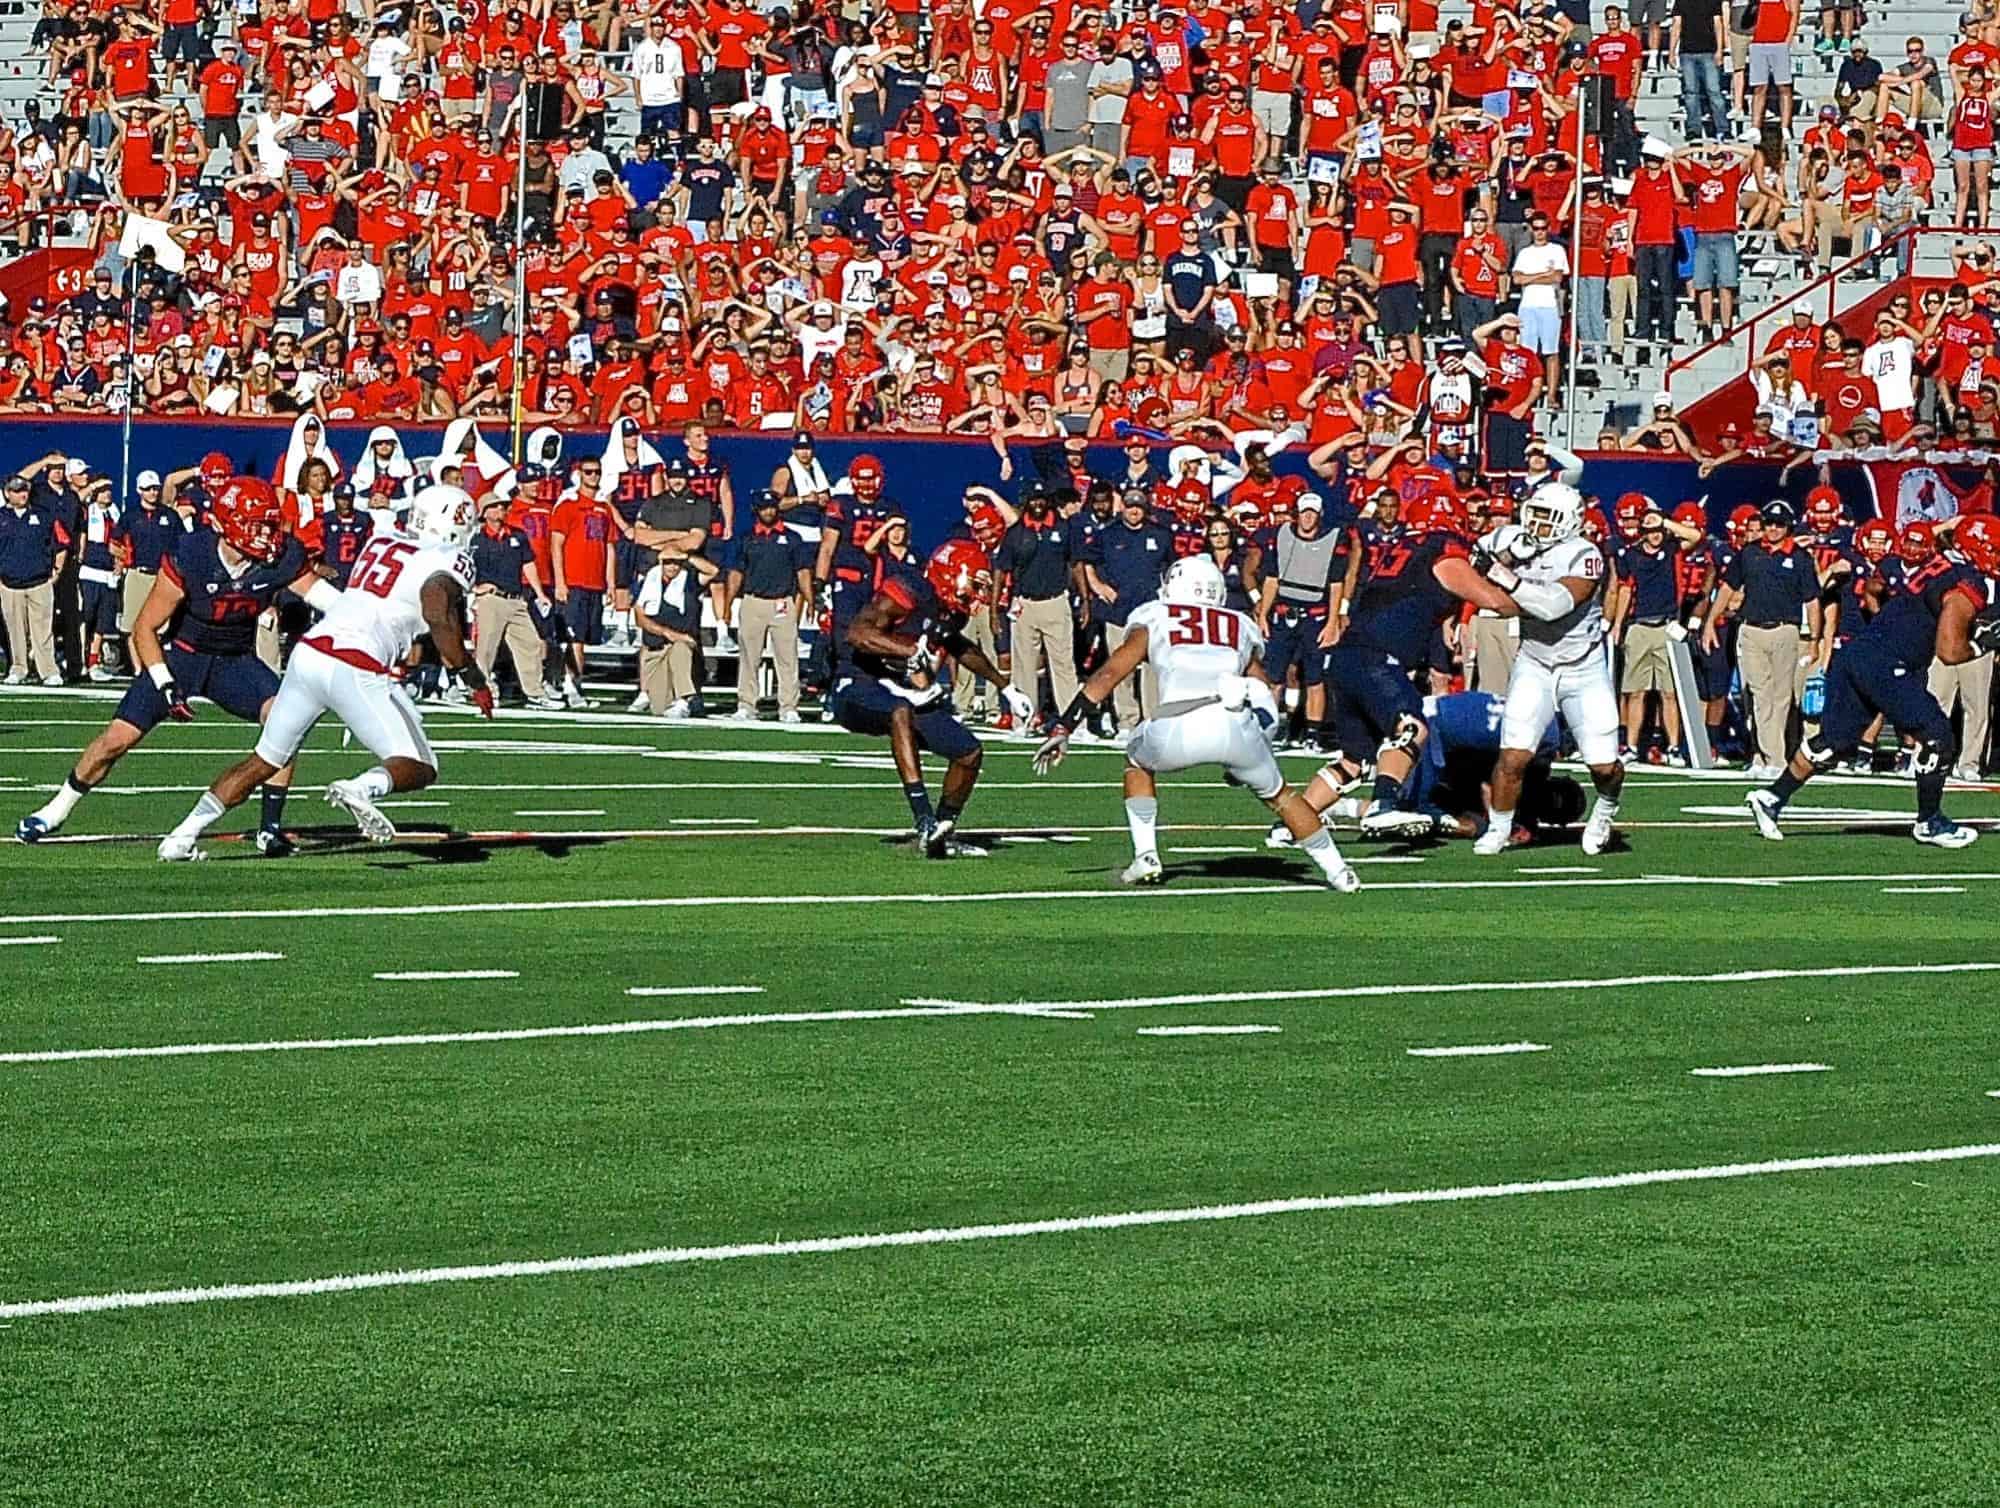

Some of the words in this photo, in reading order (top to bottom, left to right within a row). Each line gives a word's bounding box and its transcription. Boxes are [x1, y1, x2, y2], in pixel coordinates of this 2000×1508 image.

[847, 270, 877, 302] A
[347, 536, 419, 599] 55
[1167, 604, 1239, 652] 30
